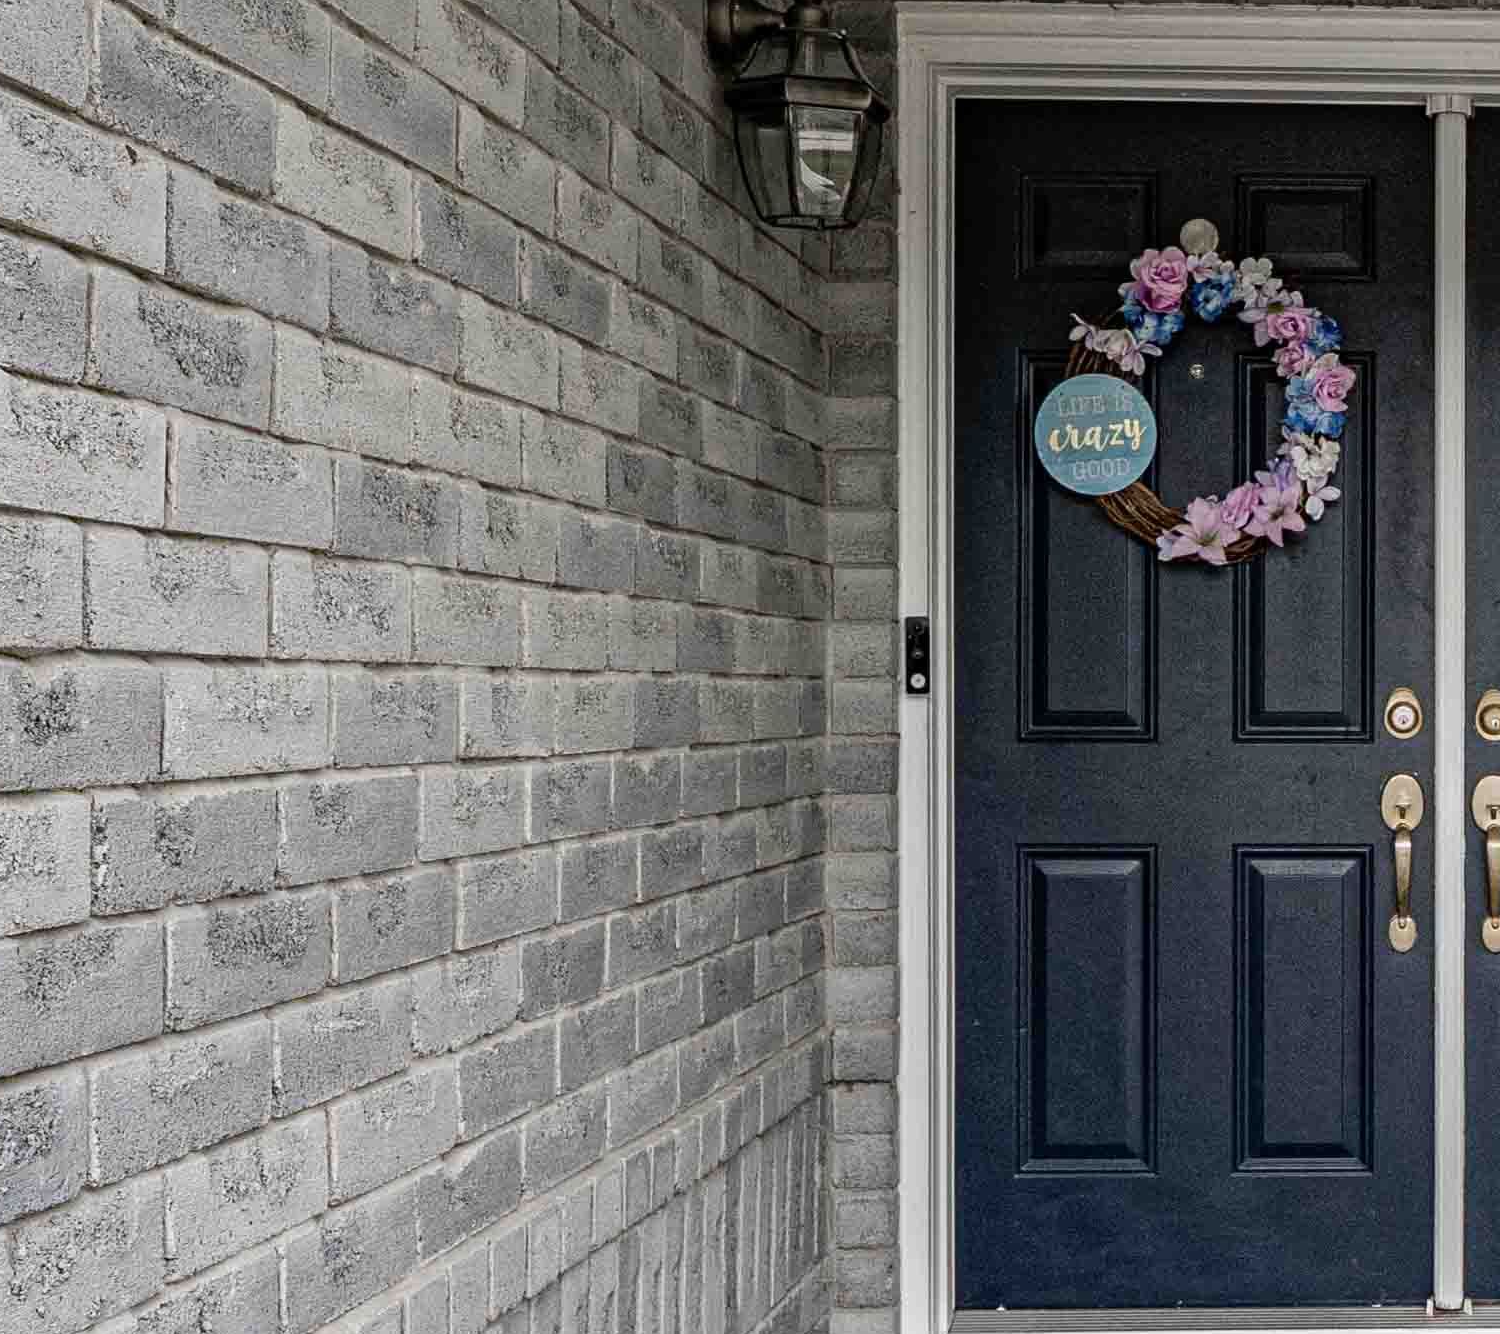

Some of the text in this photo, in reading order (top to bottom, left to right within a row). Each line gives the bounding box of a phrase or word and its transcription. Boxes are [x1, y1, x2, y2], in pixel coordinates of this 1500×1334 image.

[1057, 393, 1134, 417] LIFE IS
[1048, 418, 1148, 453] crazy
[1074, 458, 1132, 480] GOOD
